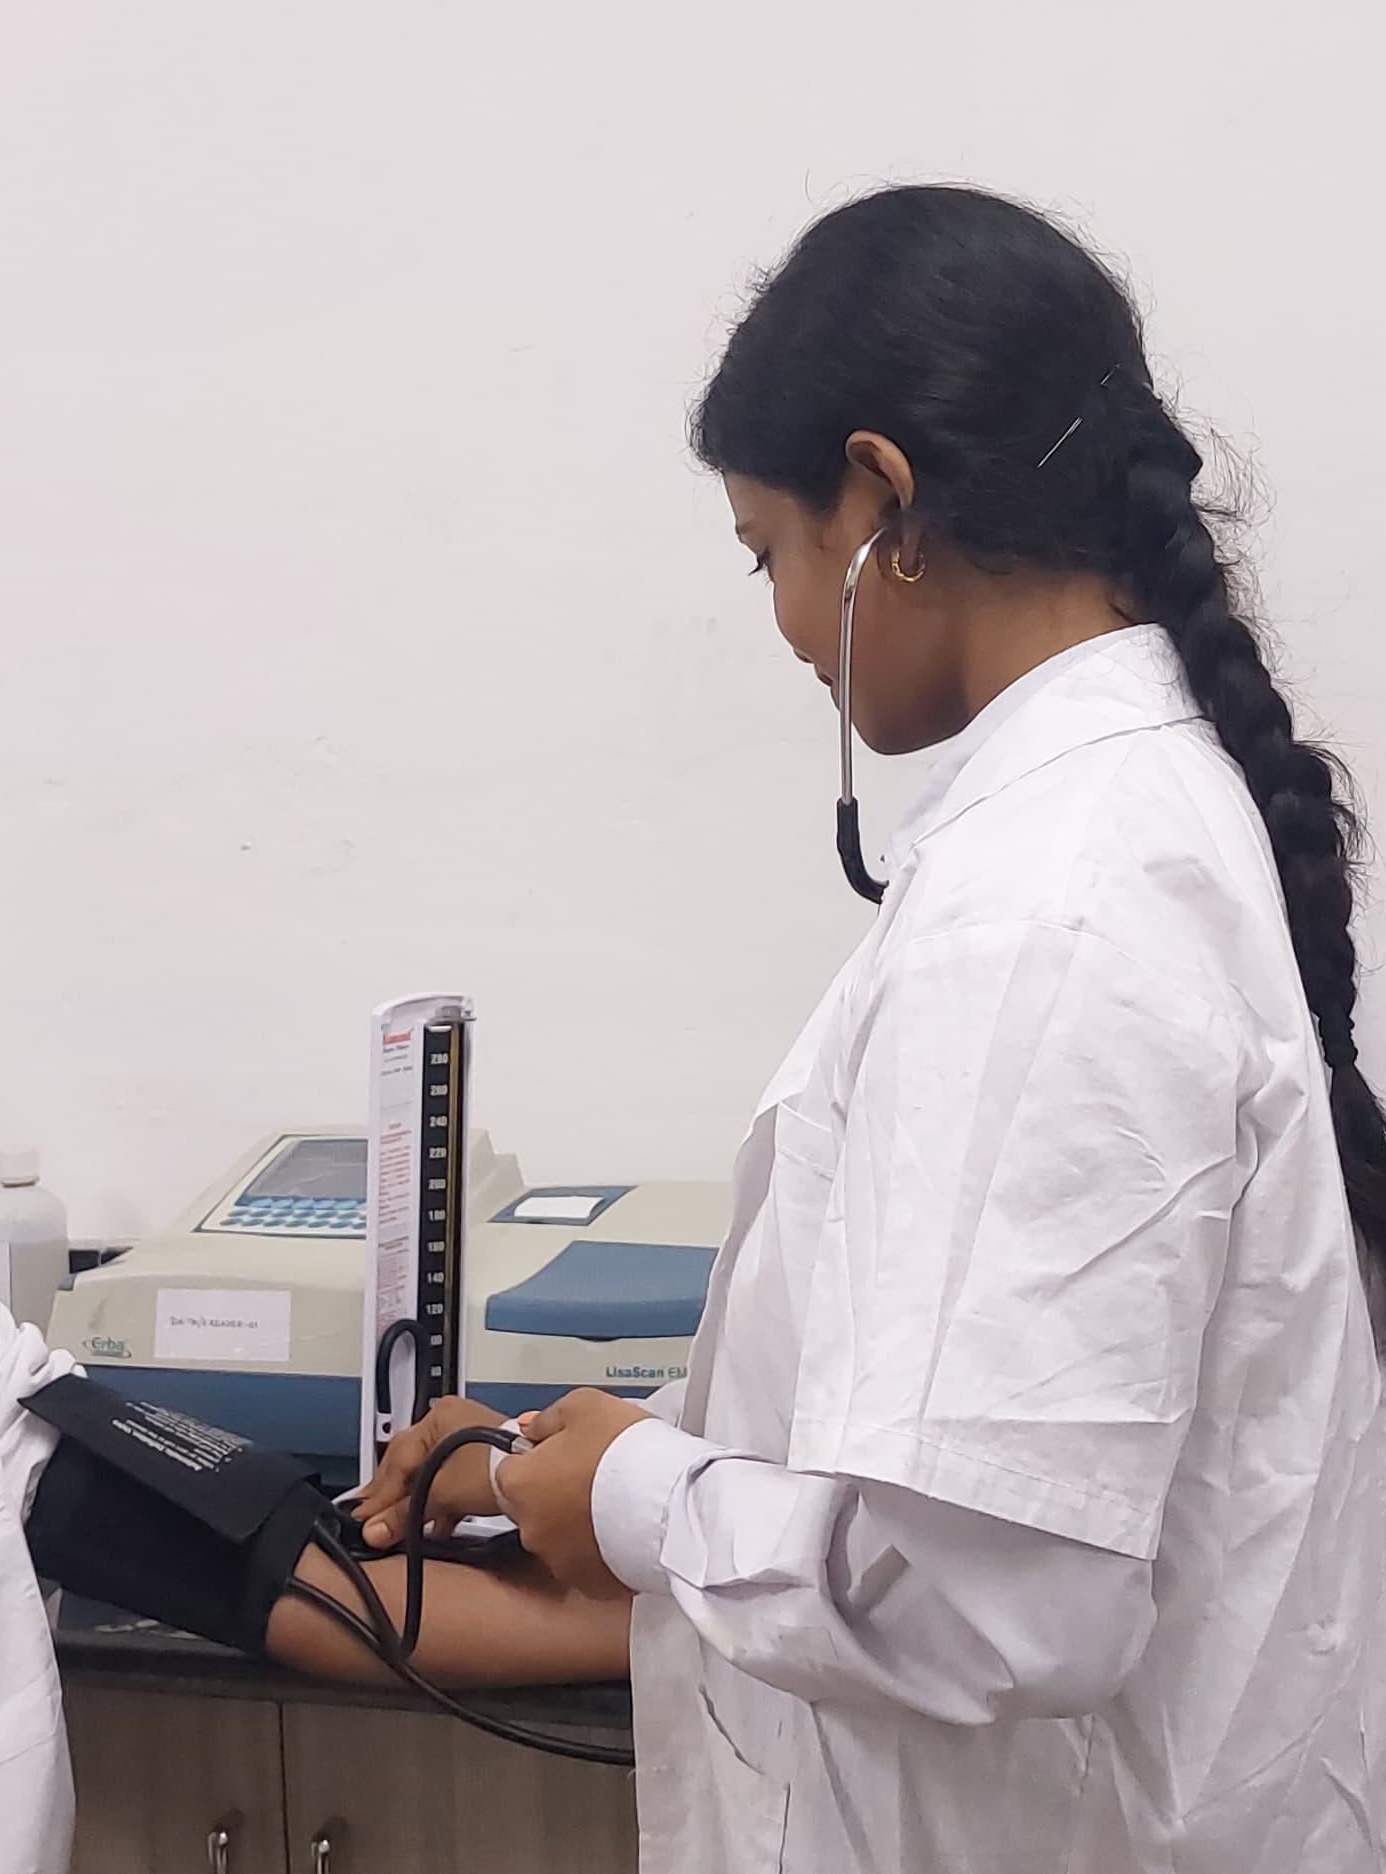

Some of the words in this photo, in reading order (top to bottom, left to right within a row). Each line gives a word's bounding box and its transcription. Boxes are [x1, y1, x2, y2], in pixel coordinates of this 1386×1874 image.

[429, 1116, 448, 1127] 240
[429, 1147, 447, 1158] 220
[427, 1272, 444, 1283] 140
[425, 1303, 444, 1315] 120
[91, 1337, 125, 1350] Erba
[606, 1366, 664, 1378] LisaScan
